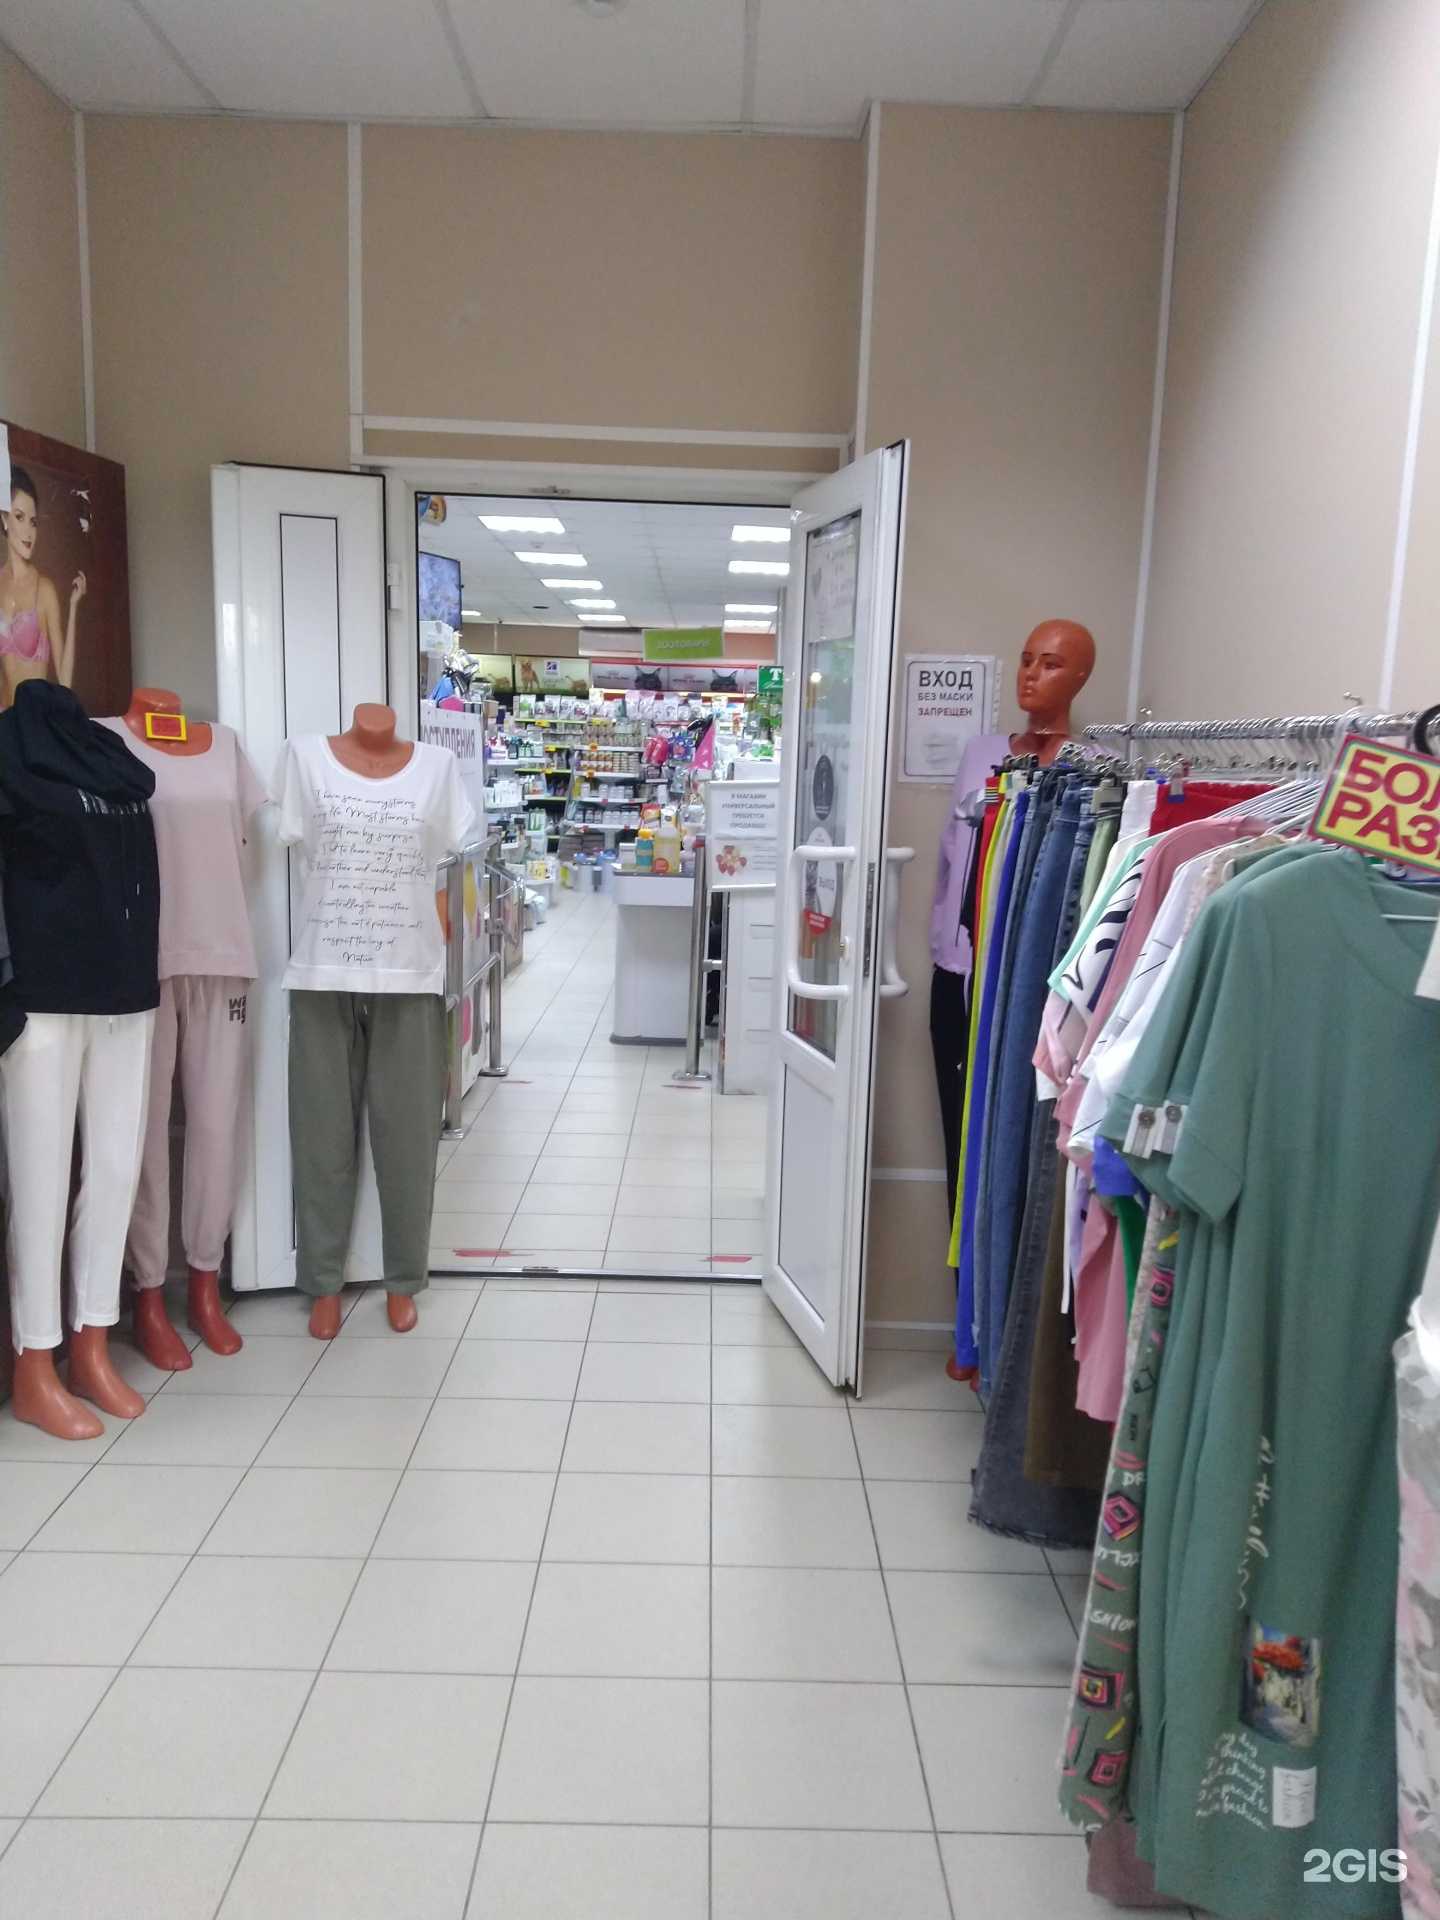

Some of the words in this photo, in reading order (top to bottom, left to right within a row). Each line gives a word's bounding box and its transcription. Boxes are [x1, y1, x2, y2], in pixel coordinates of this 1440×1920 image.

[919, 670, 973, 690] ВХОД
[918, 692, 936, 701] БЕЗ
[939, 692, 973, 701] МАСКИ
[918, 707, 973, 717] ЗАПРЕЩЕН
